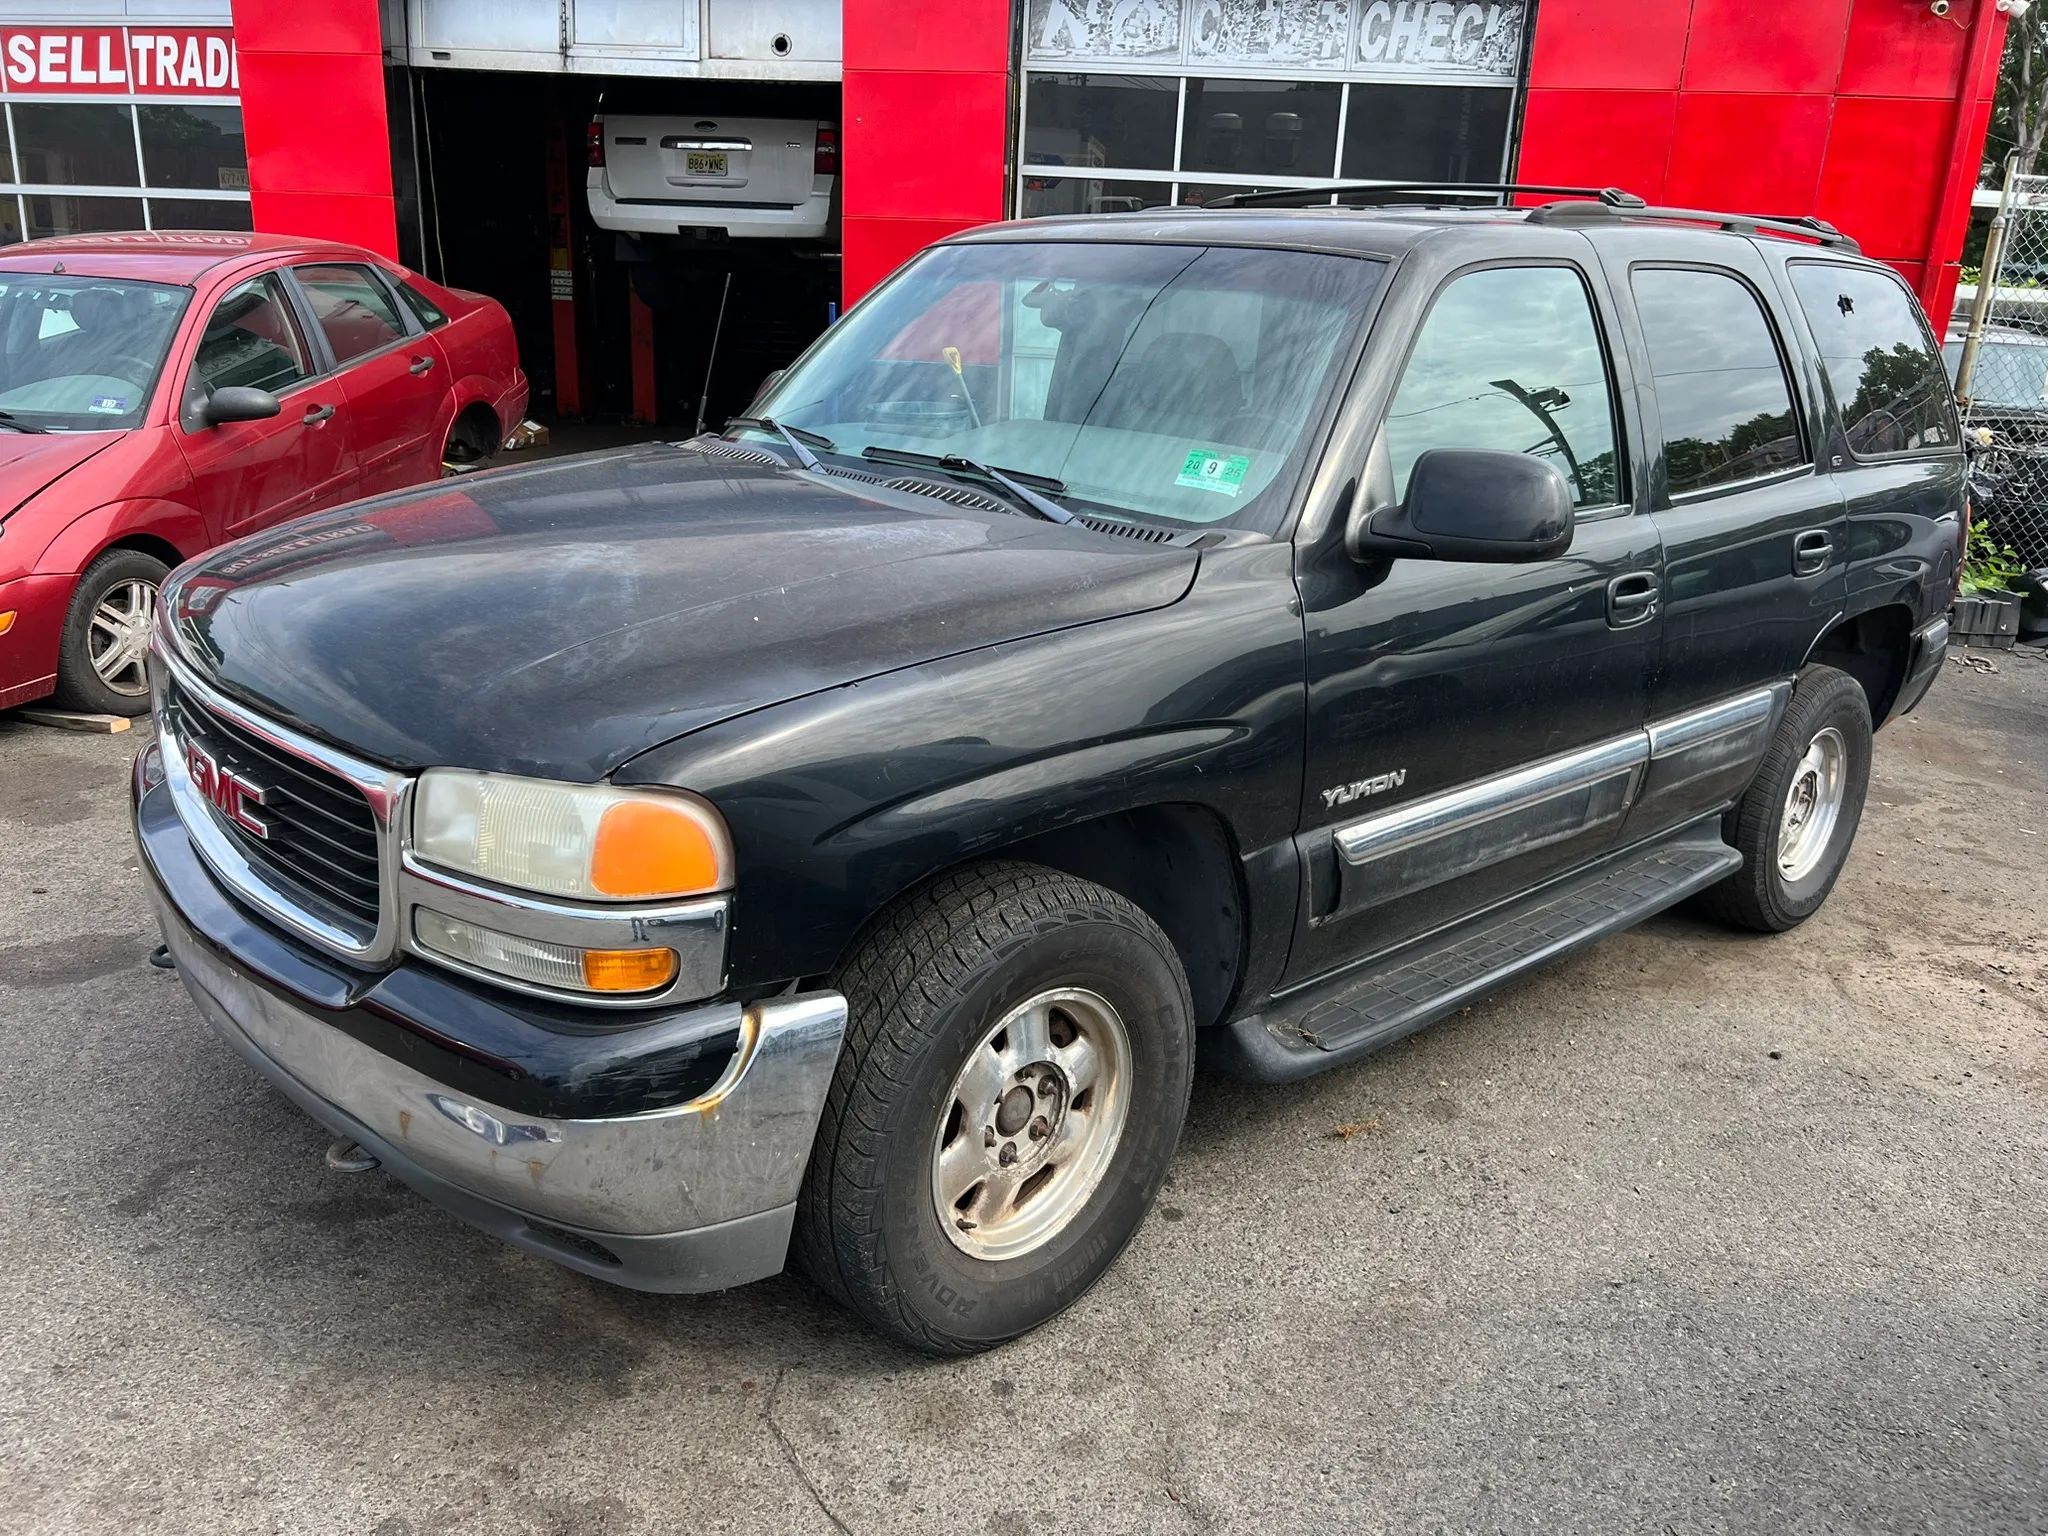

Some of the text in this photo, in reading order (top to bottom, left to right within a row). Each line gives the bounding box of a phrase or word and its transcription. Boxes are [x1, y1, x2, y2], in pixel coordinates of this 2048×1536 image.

[7, 34, 126, 84] SELL
[1207, 462, 1218, 475] 9
[186, 738, 268, 840] GMC
[1321, 768, 1407, 809] YUKON
